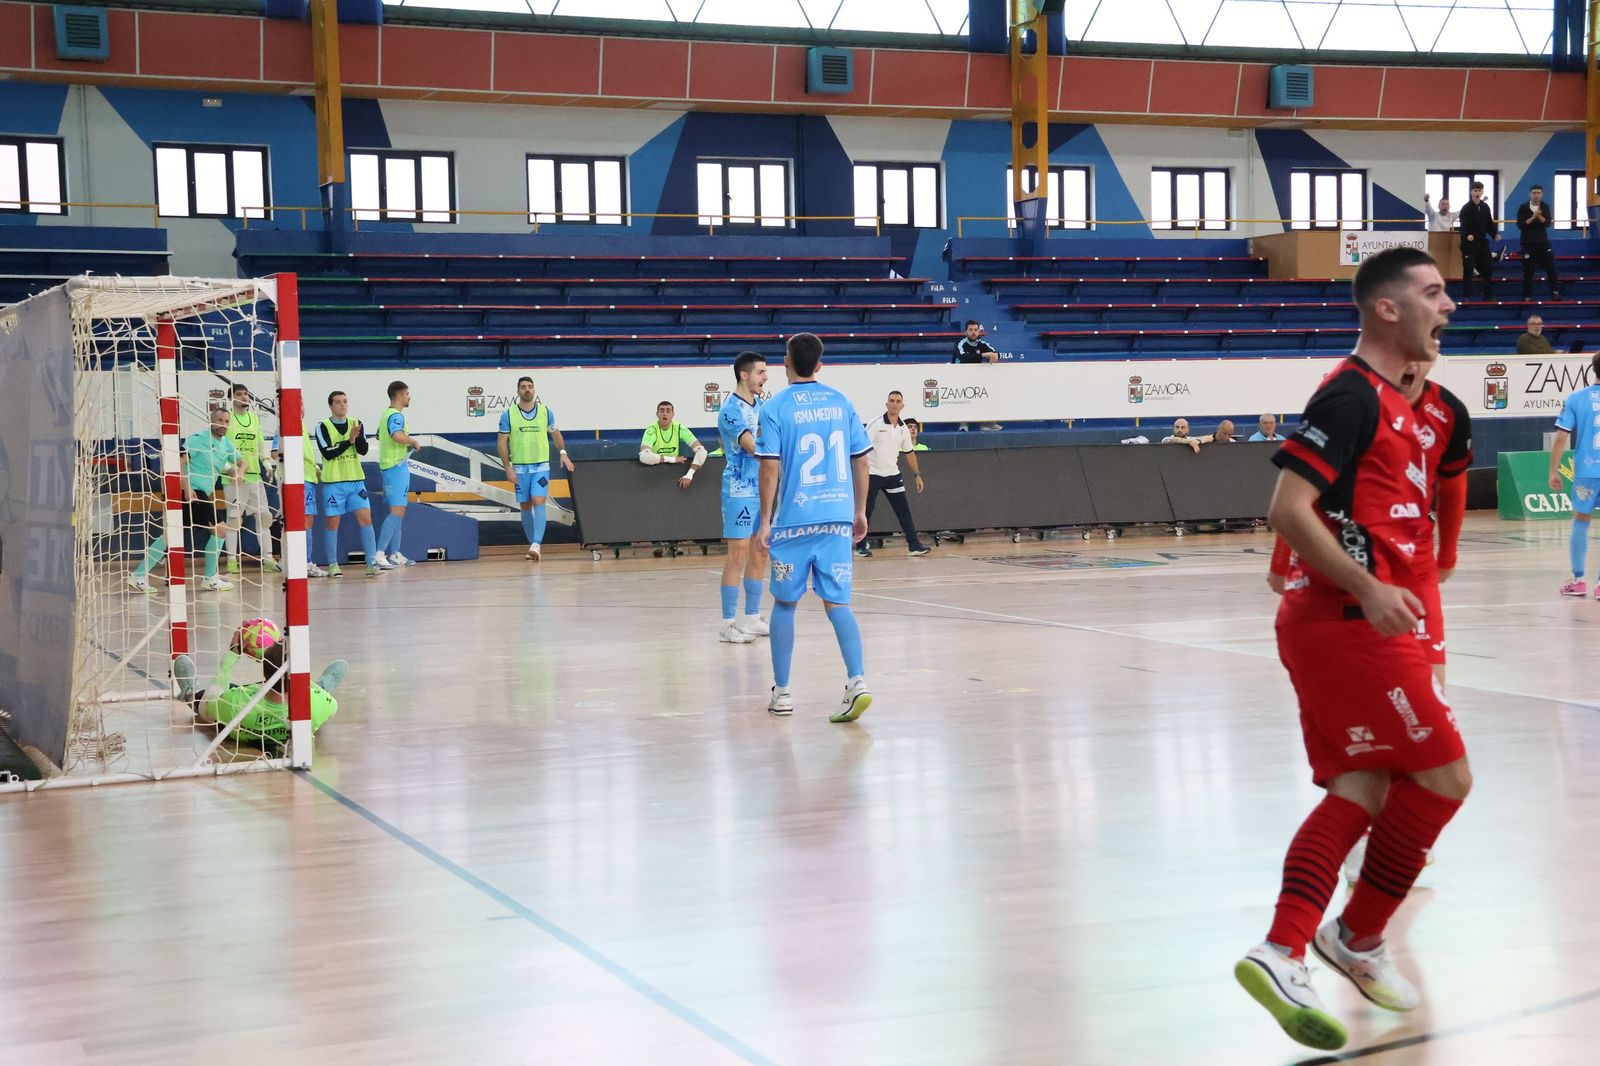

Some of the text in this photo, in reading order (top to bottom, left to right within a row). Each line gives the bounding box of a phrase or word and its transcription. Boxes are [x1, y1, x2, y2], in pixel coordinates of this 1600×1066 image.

[1525, 362, 1593, 394] ZAM
[940, 386, 989, 400] ZAMORA
[1144, 383, 1190, 395] ZAMORA
[487, 394, 542, 408] ZAMA
[1523, 400, 1566, 409] AYUNTA
[794, 409, 815, 425] ISMA
[798, 430, 849, 487] 21
[440, 472, 466, 486] Sports
[1524, 493, 1574, 513] CAJA
[771, 524, 850, 542] SALAMANC
